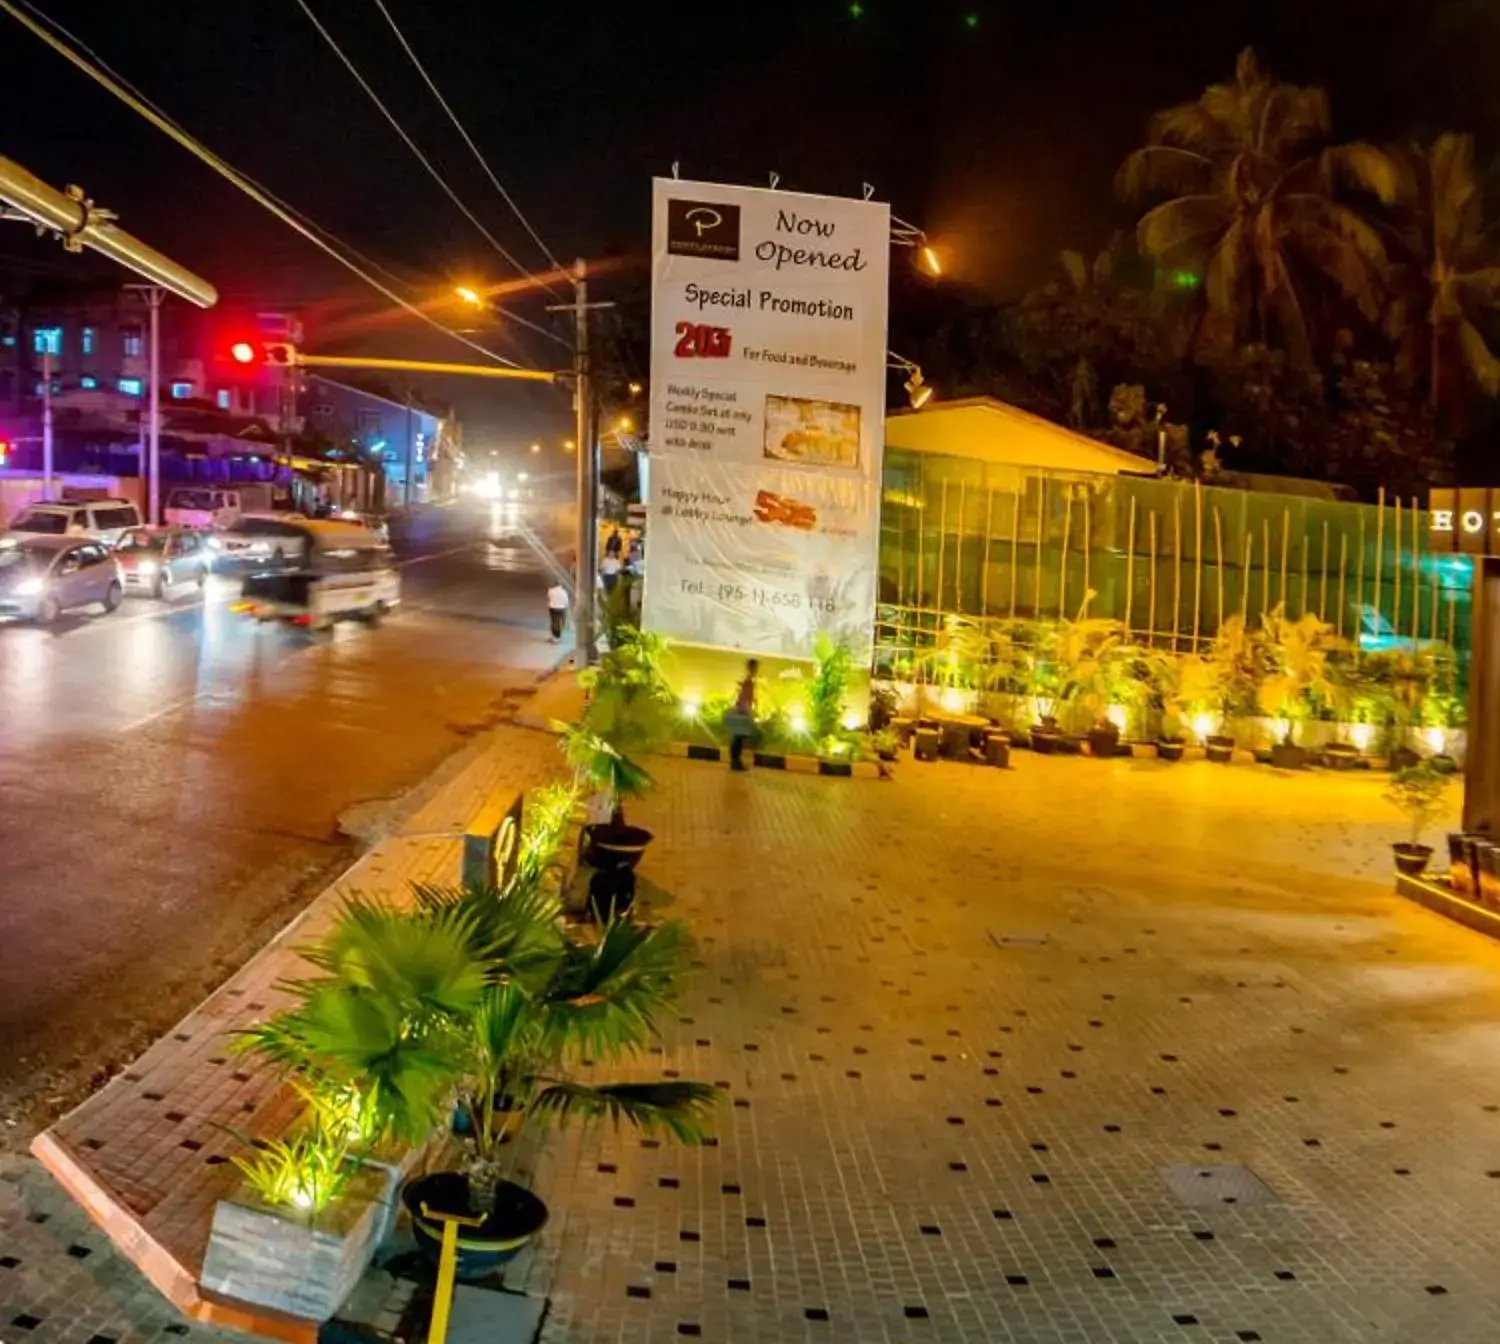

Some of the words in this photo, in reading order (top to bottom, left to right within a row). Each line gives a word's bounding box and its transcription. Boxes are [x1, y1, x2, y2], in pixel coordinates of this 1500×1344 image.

[776, 208, 836, 238] Now
[755, 240, 868, 272] Opened
[685, 283, 752, 310] Special
[759, 291, 854, 321] Promotion
[762, 348, 787, 364] Food
